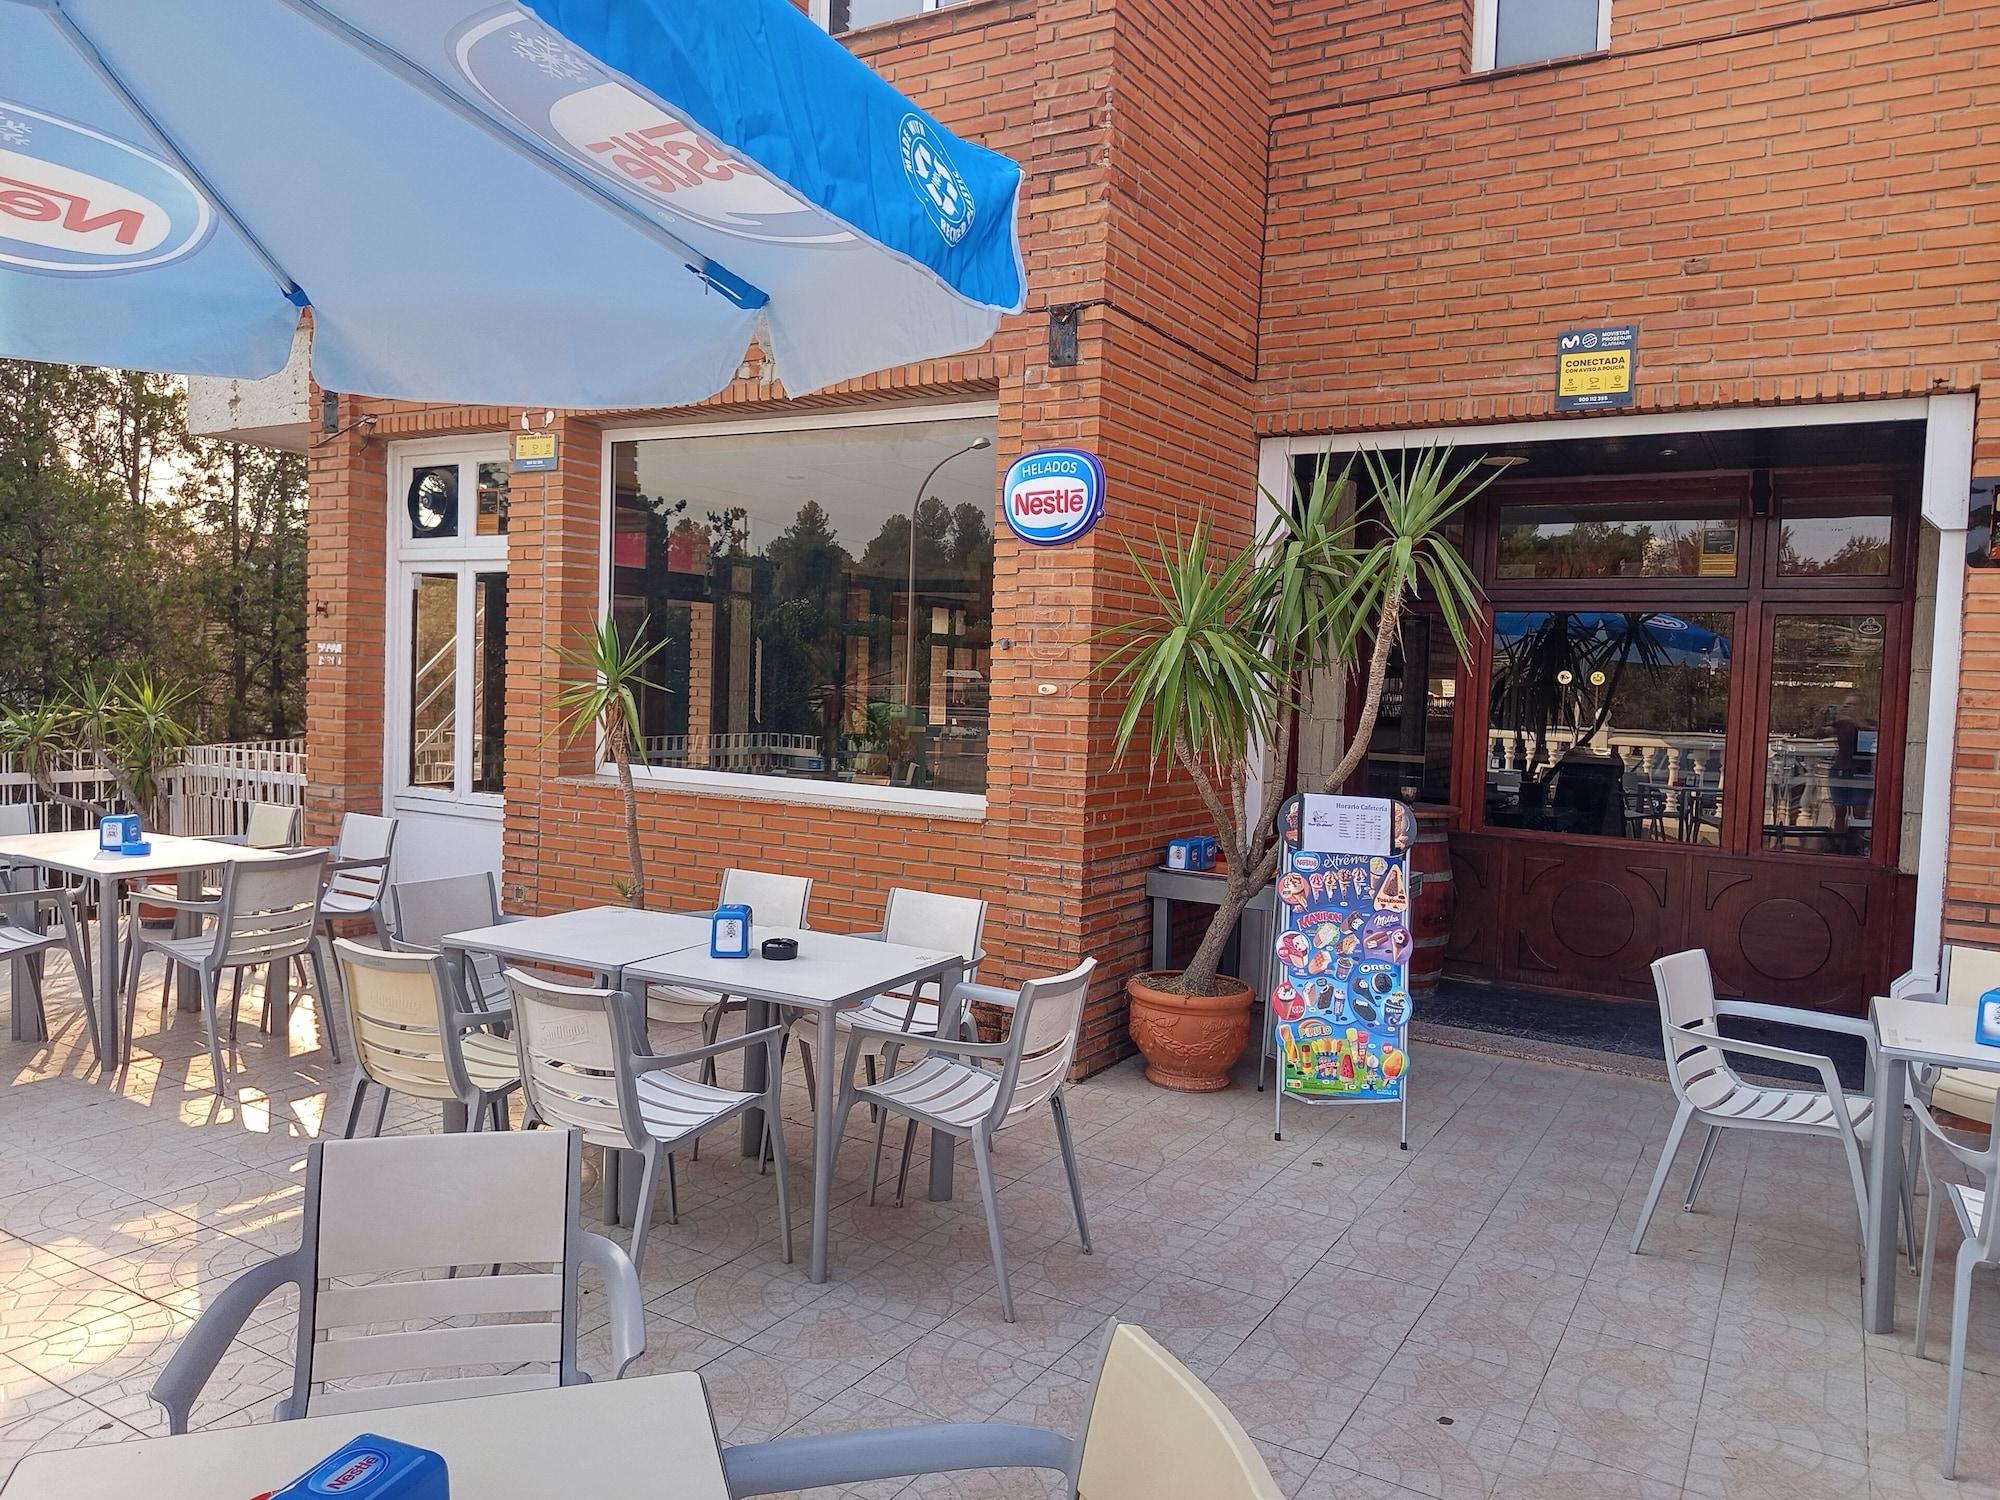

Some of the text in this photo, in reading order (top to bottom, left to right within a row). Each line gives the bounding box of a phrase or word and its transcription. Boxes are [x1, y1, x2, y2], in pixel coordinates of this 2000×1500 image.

[902, 119, 926, 174] MADE WITH
[1565, 356, 1625, 368] CONECTADA
[1022, 461, 1078, 478] HELADOS
[1015, 488, 1084, 517] Nestlé
[1336, 802, 1360, 810] Horario
[1297, 911, 1342, 931] MAXIBON
[1374, 914, 1400, 926] Milka
[1360, 964, 1391, 973] OREO
